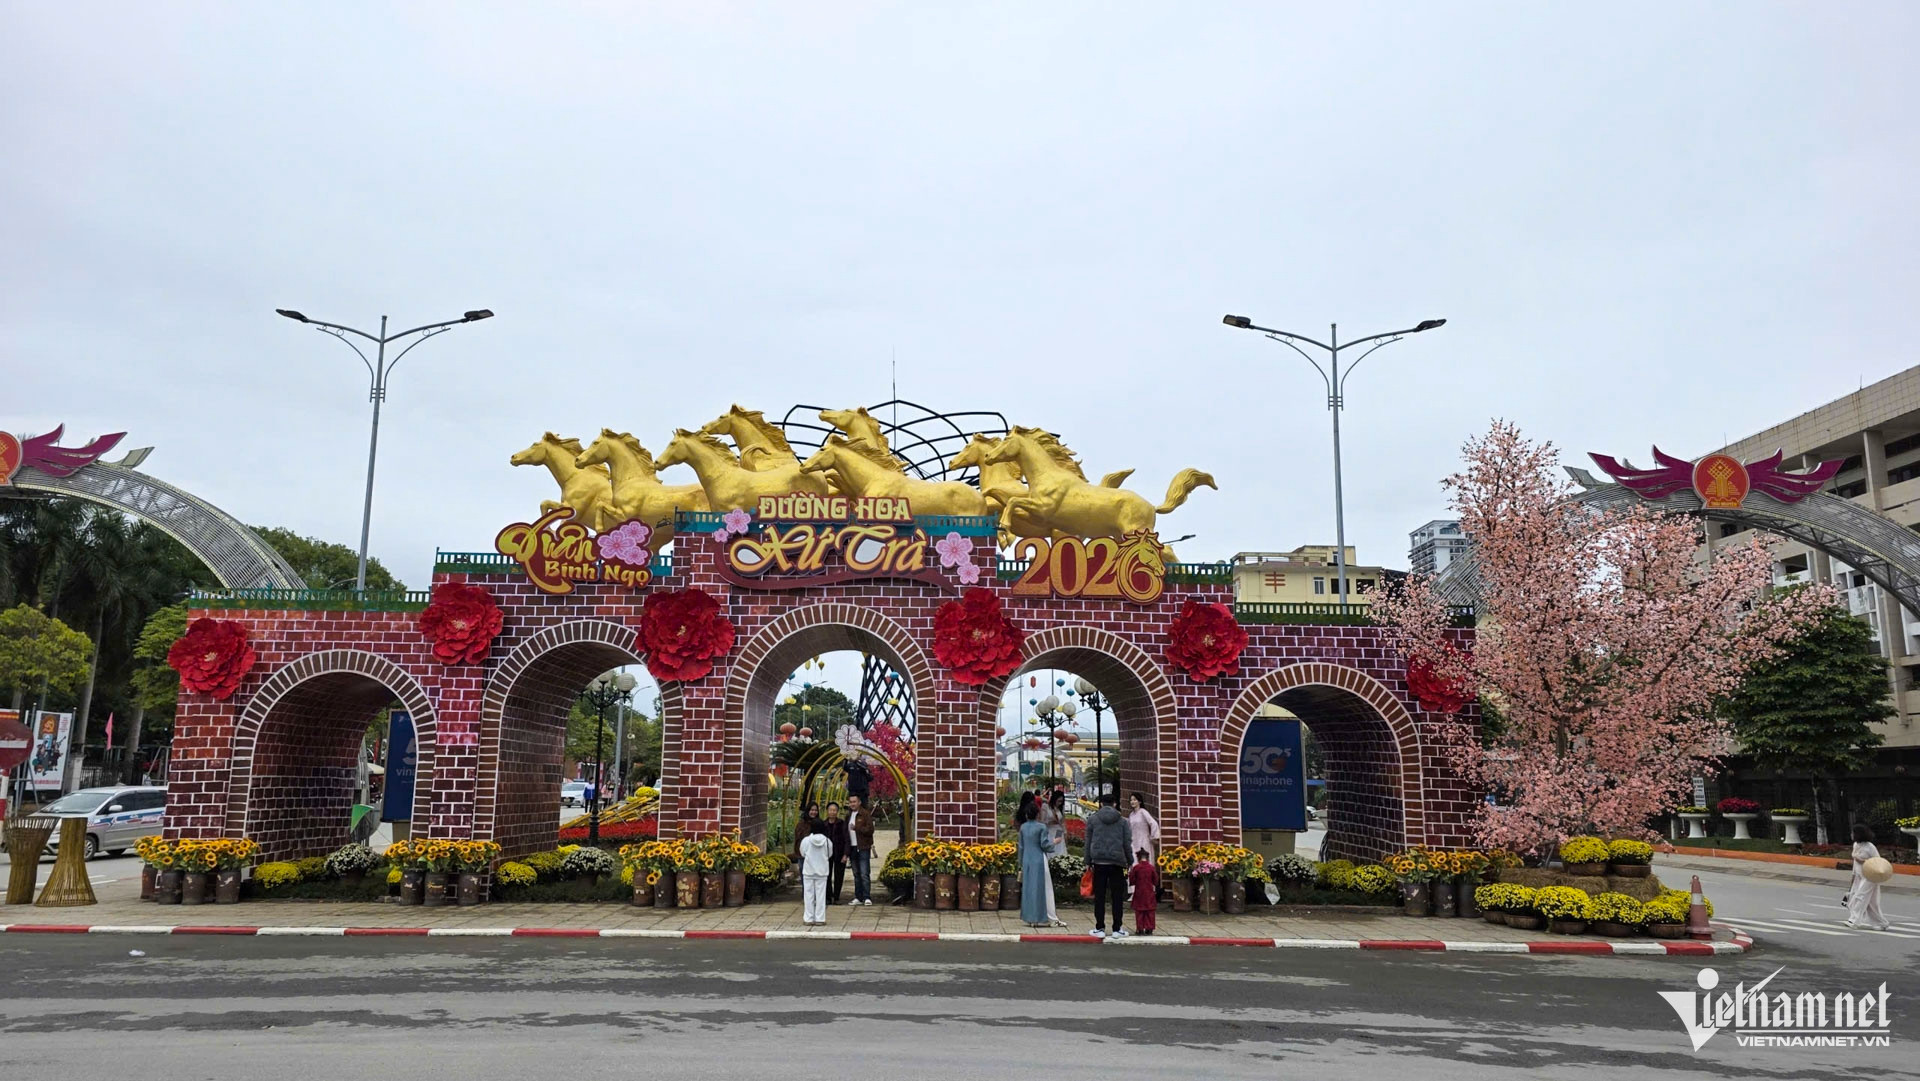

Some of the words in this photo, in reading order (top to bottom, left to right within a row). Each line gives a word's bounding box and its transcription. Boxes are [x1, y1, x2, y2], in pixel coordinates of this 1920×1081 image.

[759, 492, 847, 519] ĐƯỜNG
[855, 498, 910, 520] HOA
[498, 509, 596, 594] Xuân
[730, 524, 835, 572] Xứ
[835, 525, 927, 571] Trà
[1012, 529, 1166, 602] 2026
[604, 564, 649, 587] Ngọ
